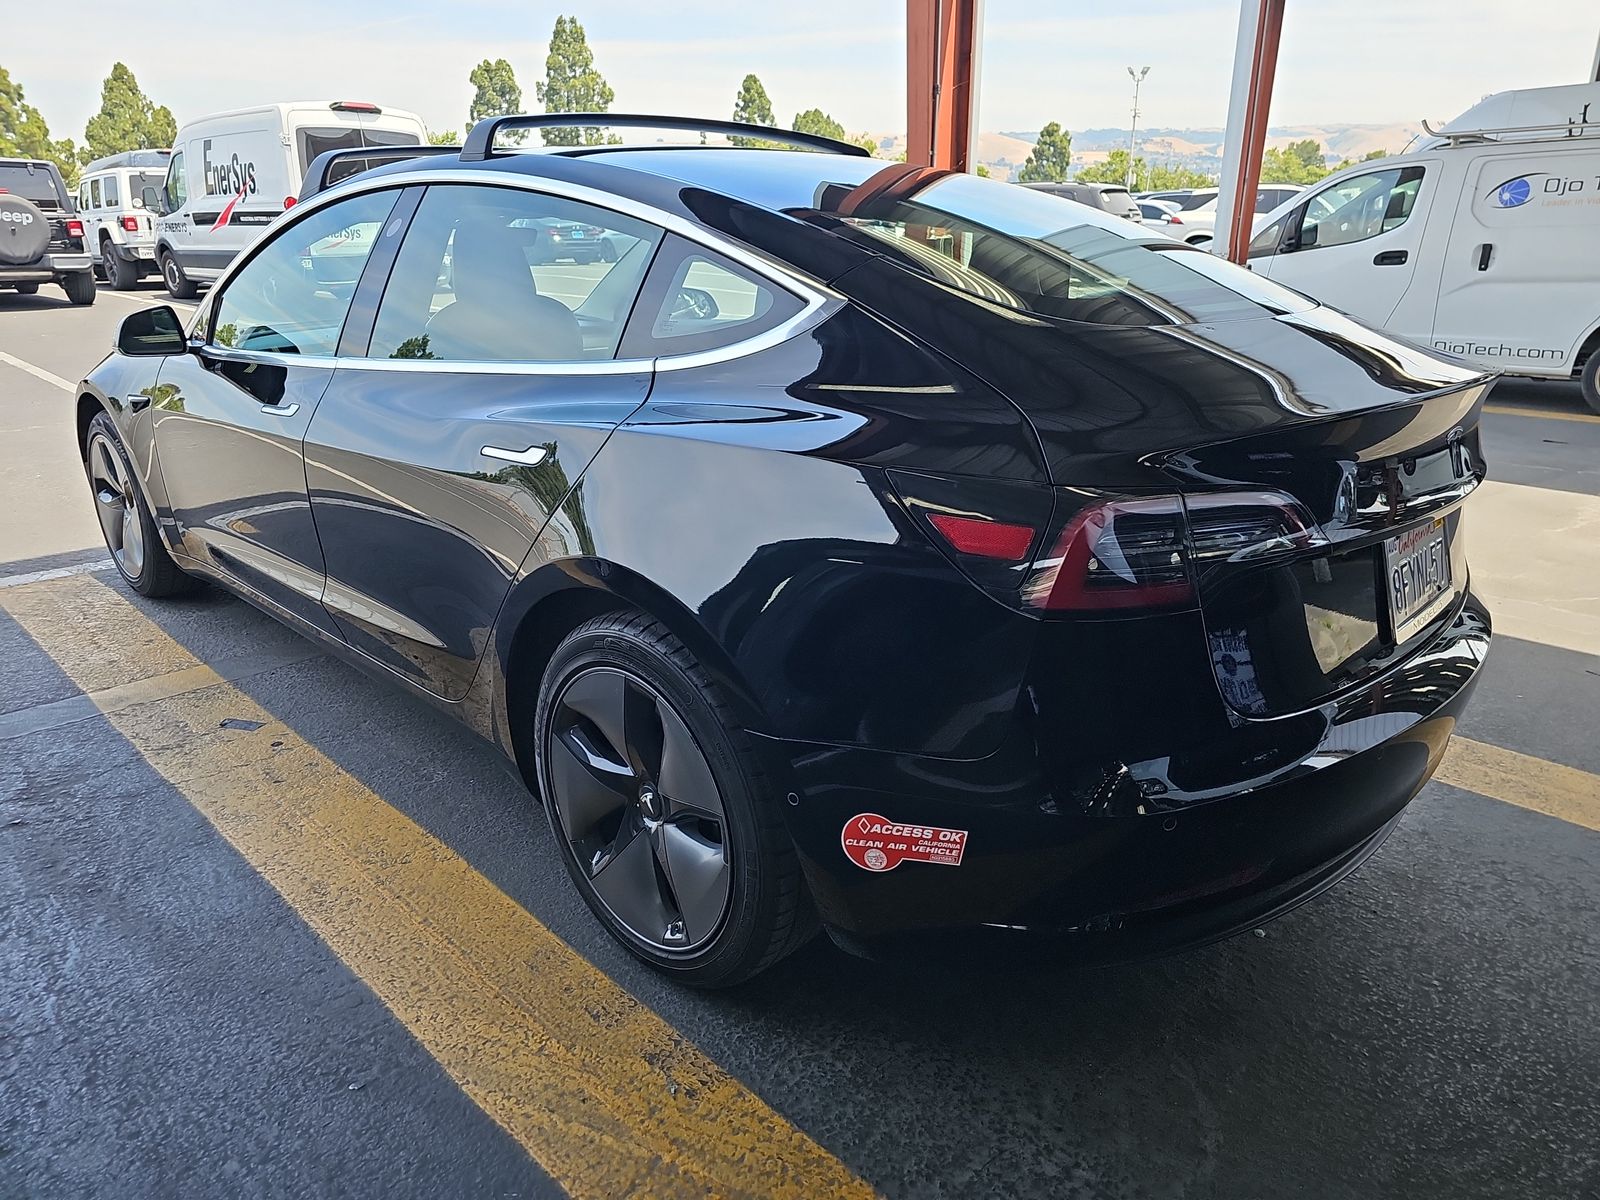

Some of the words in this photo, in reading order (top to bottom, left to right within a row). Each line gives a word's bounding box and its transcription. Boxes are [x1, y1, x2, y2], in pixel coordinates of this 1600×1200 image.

[203, 139, 256, 203] EnerSys
[1544, 177, 1584, 196] Ojo
[0, 208, 33, 225] eep
[1398, 522, 1435, 555] California
[1412, 606, 1437, 630] MODEL
[870, 824, 934, 839] ACCESS
[938, 831, 963, 842] OK
[845, 838, 884, 848] CLEAN
[887, 842, 908, 851] AIR
[911, 845, 960, 857] VEHICLE
[918, 839, 961, 850] CALIFORNIA
